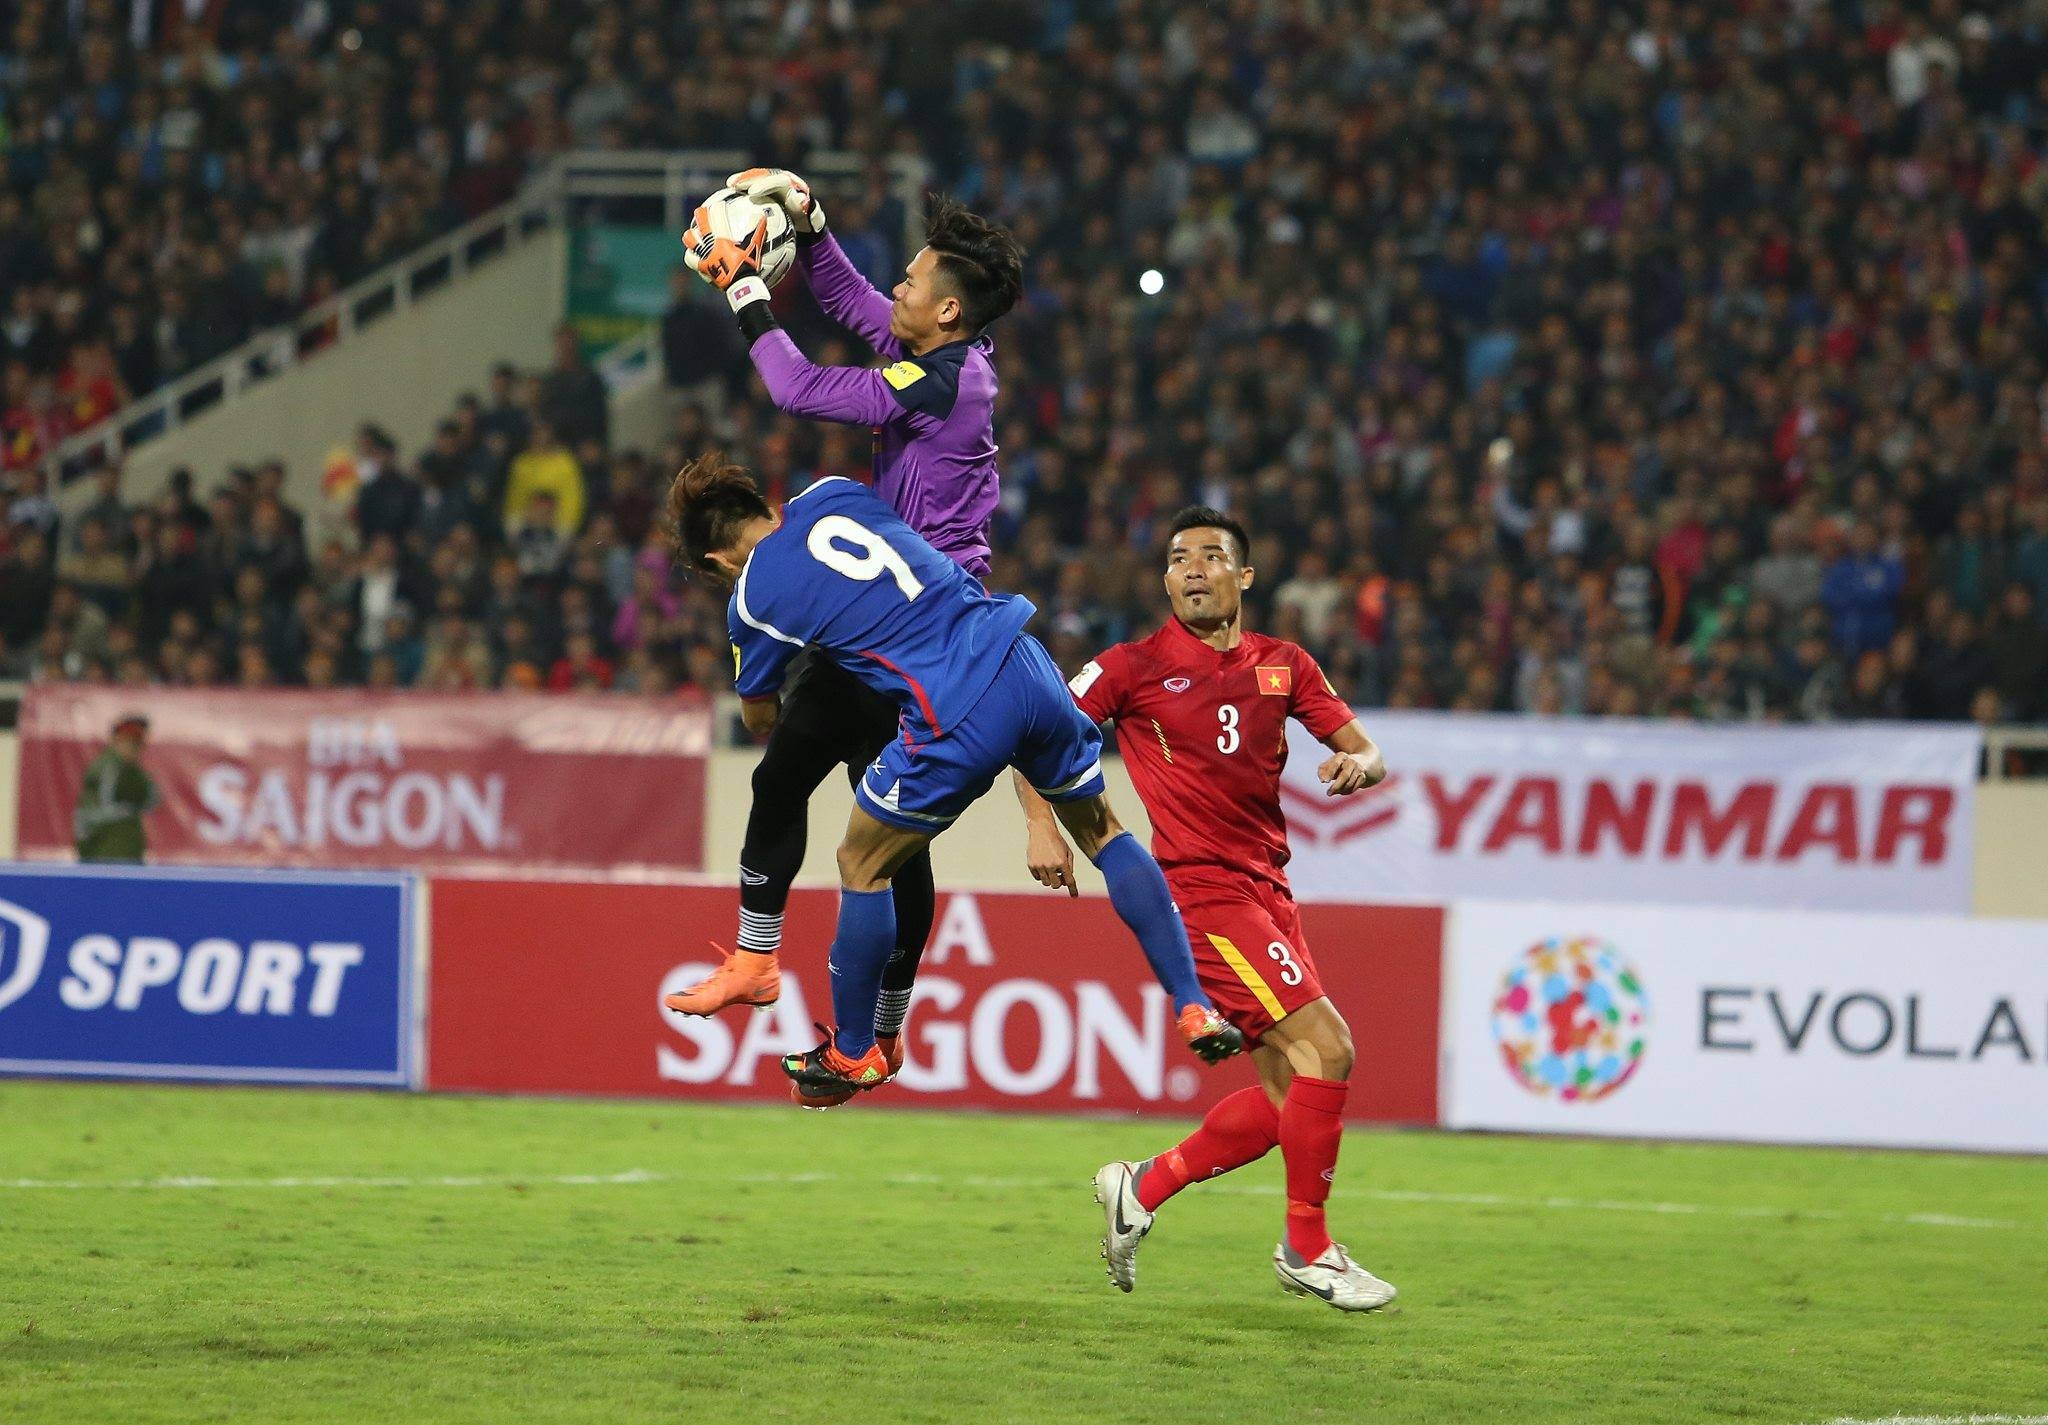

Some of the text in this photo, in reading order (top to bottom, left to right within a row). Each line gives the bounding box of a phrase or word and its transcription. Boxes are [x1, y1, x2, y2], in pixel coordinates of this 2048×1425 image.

[807, 514, 926, 603] 9
[1216, 703, 1241, 755] 3
[198, 761, 505, 851] SAIGON
[1418, 770, 1957, 868] YANMAR
[59, 933, 366, 1017] SPORT
[1267, 941, 1303, 986] 3
[656, 960, 1168, 1102] SAGON
[1697, 985, 2048, 1062] EVOLA
